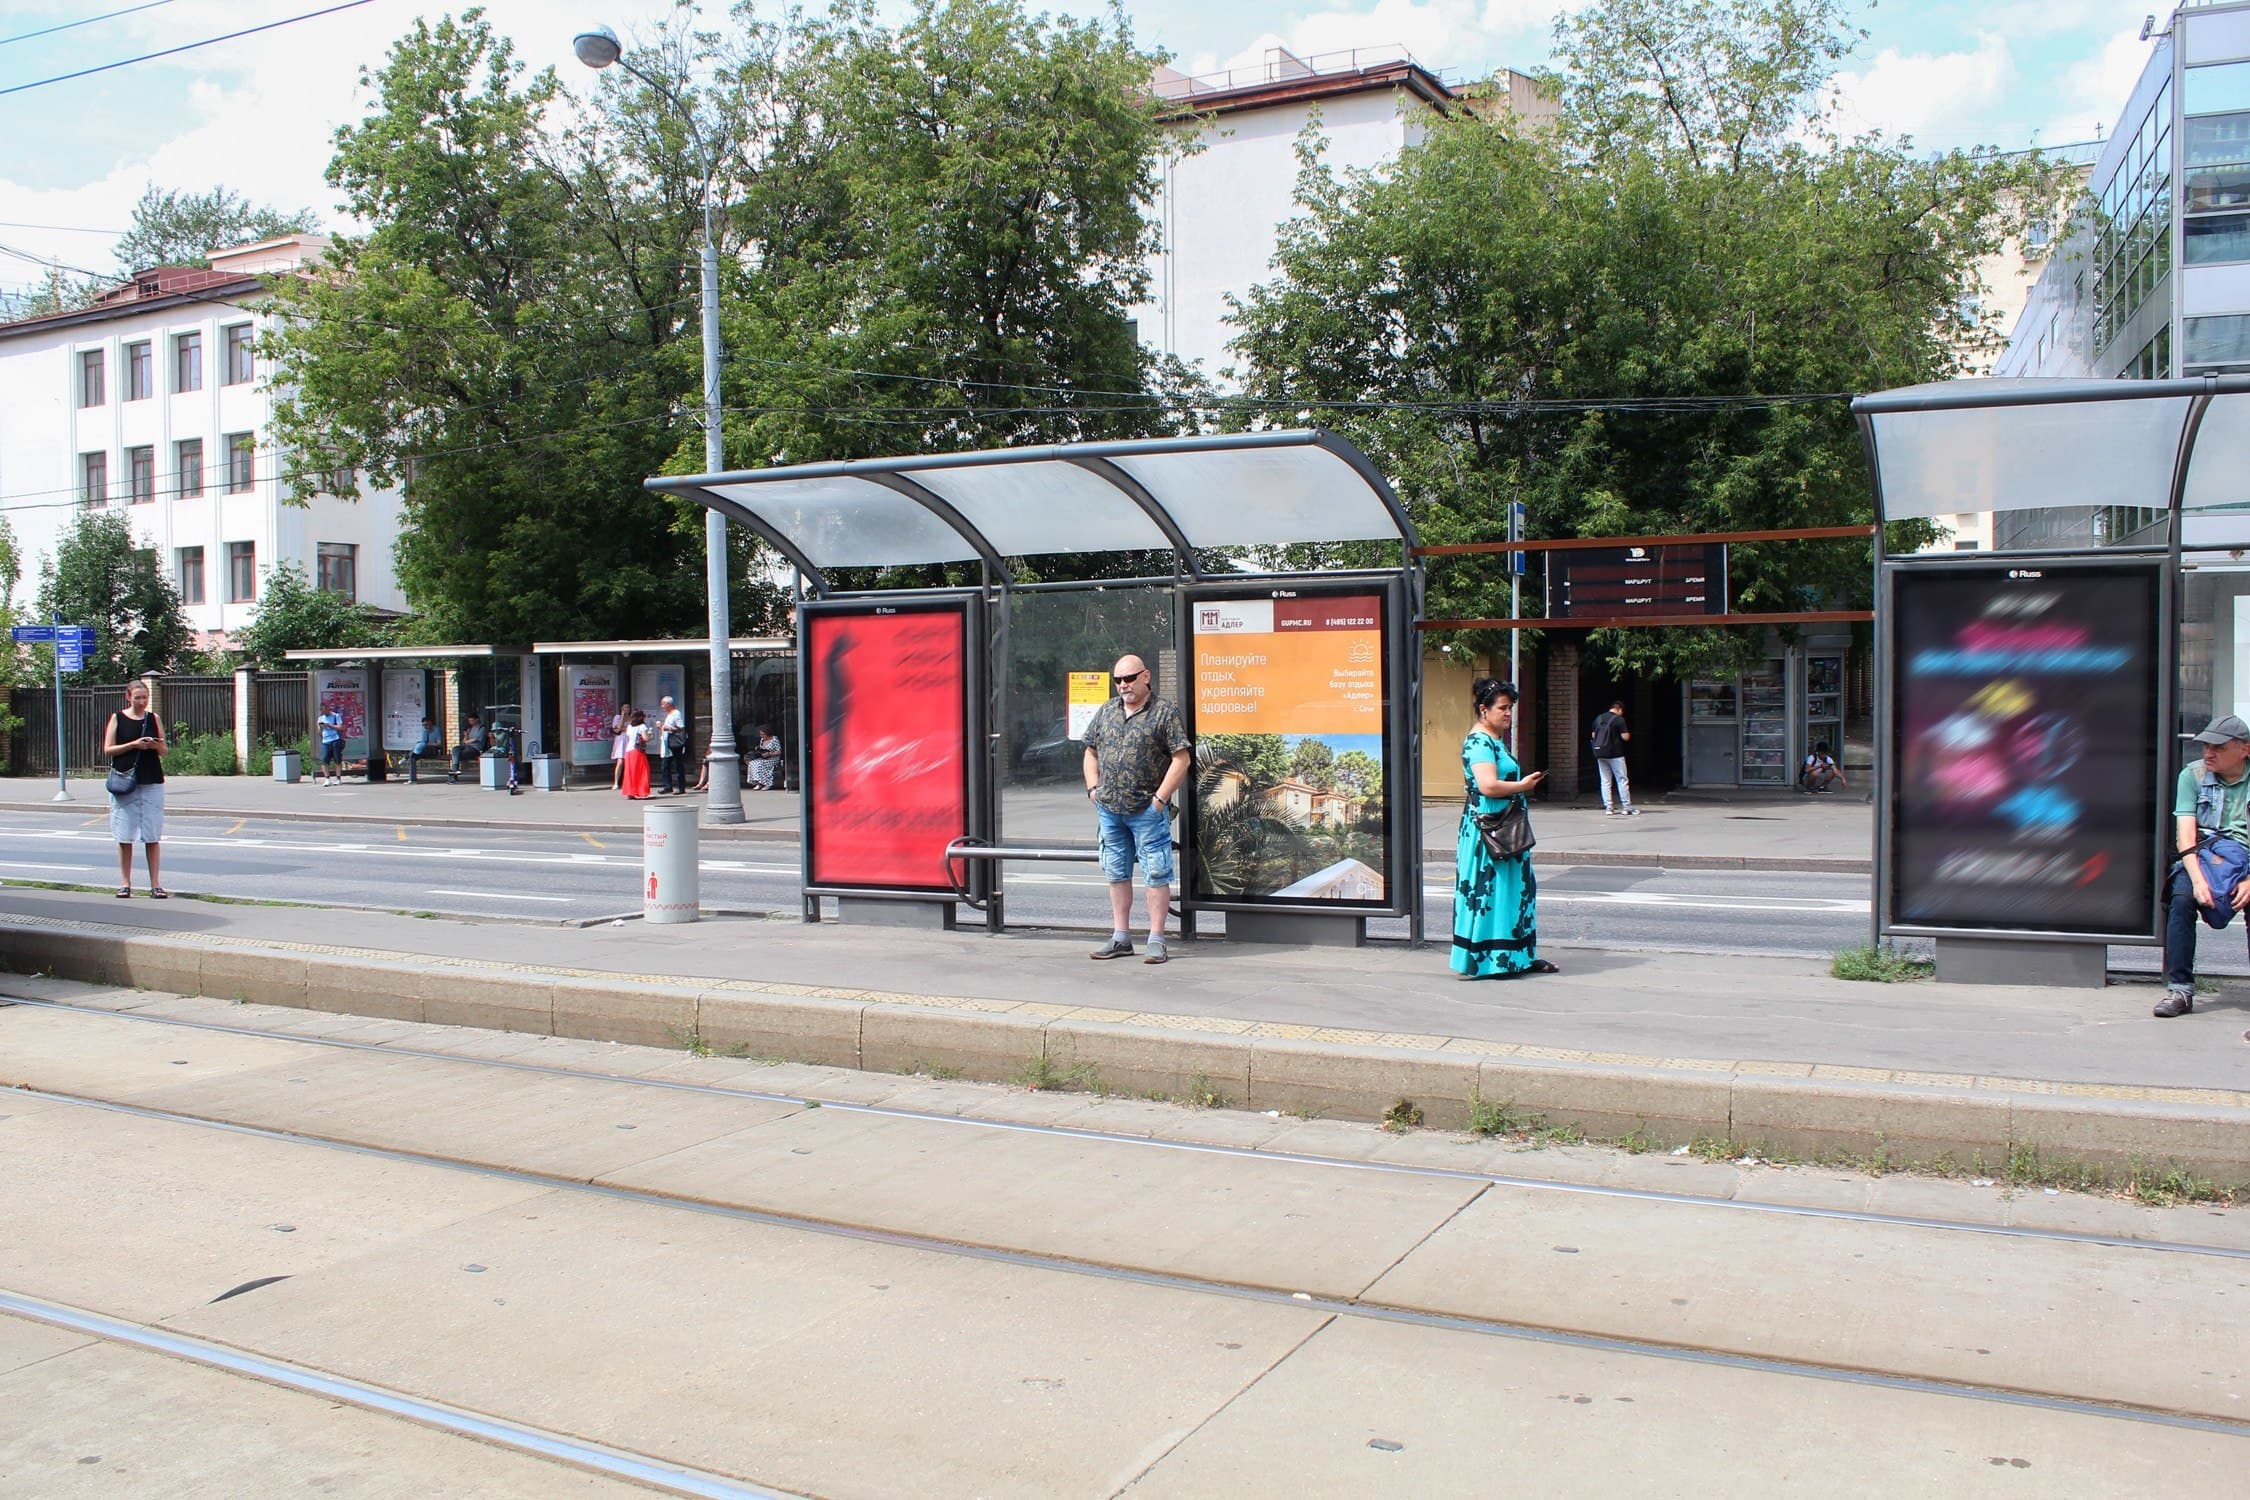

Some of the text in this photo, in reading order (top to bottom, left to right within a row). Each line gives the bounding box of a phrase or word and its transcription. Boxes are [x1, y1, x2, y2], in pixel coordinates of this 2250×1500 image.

[2019, 569, 2042, 578] Russ
[1221, 621, 1244, 629] АДЛЕР
[1281, 619, 1312, 627] GUPMC.RU
[1200, 652, 1267, 669] Планируйте
[1200, 671, 1236, 684] отдых,
[1200, 683, 1265, 700] укрепляйте
[1200, 701, 1257, 715] здоровье!
